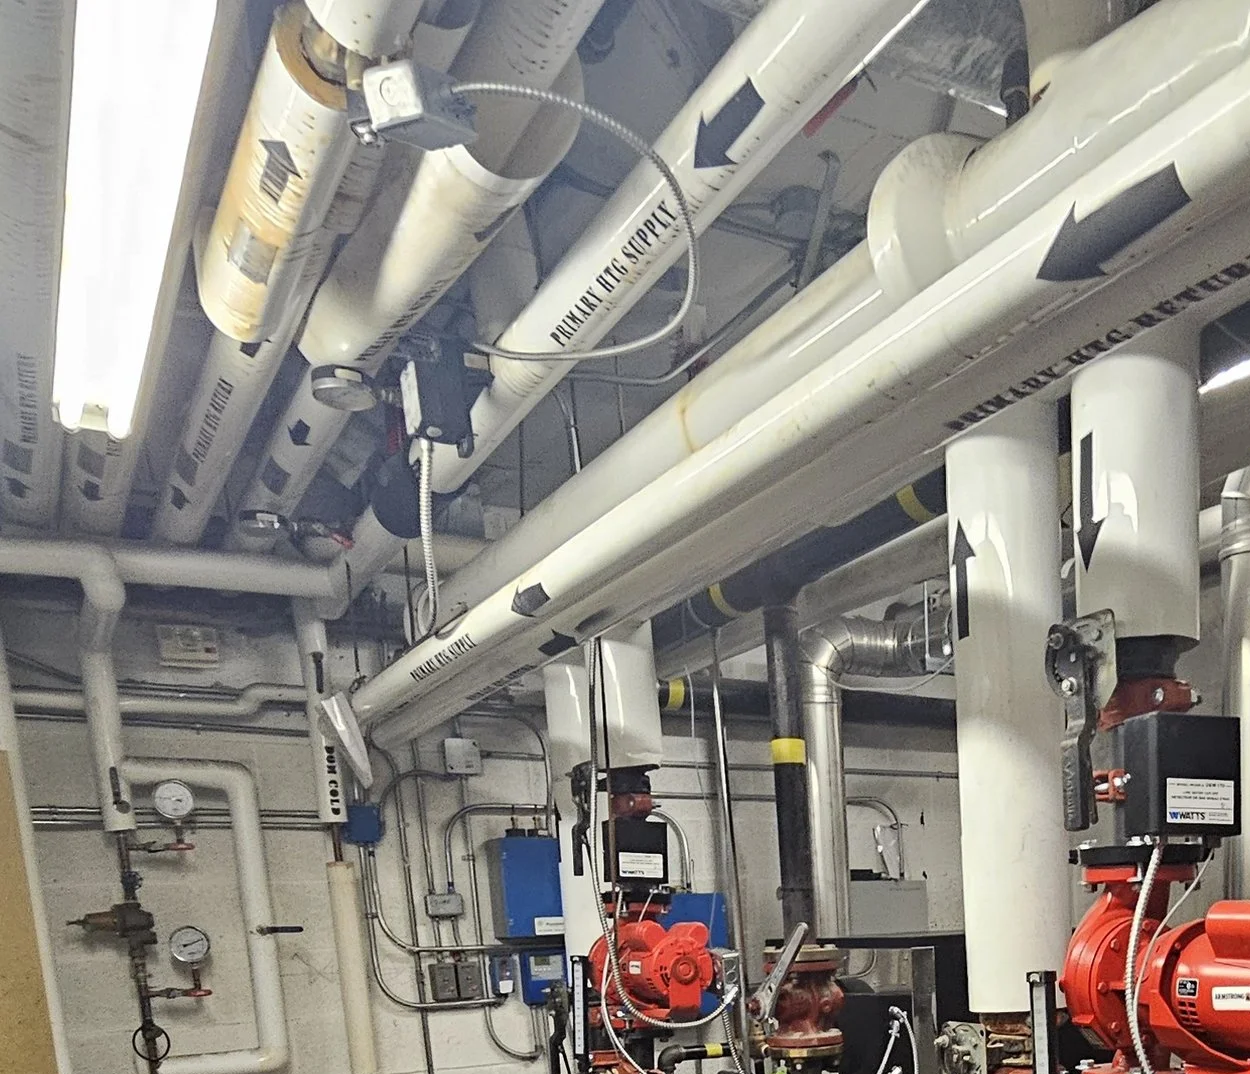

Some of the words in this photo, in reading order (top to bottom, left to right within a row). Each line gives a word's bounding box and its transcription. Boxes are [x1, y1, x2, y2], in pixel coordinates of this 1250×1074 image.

[549, 286, 604, 348] PRIMARY
[594, 257, 629, 294] HTG
[620, 198, 678, 265] SUPPLY
[944, 364, 1058, 433] PRIMARY
[324, 745, 338, 775] DOM
[328, 779, 342, 816] COLD
[1179, 811, 1207, 821] WATTS
